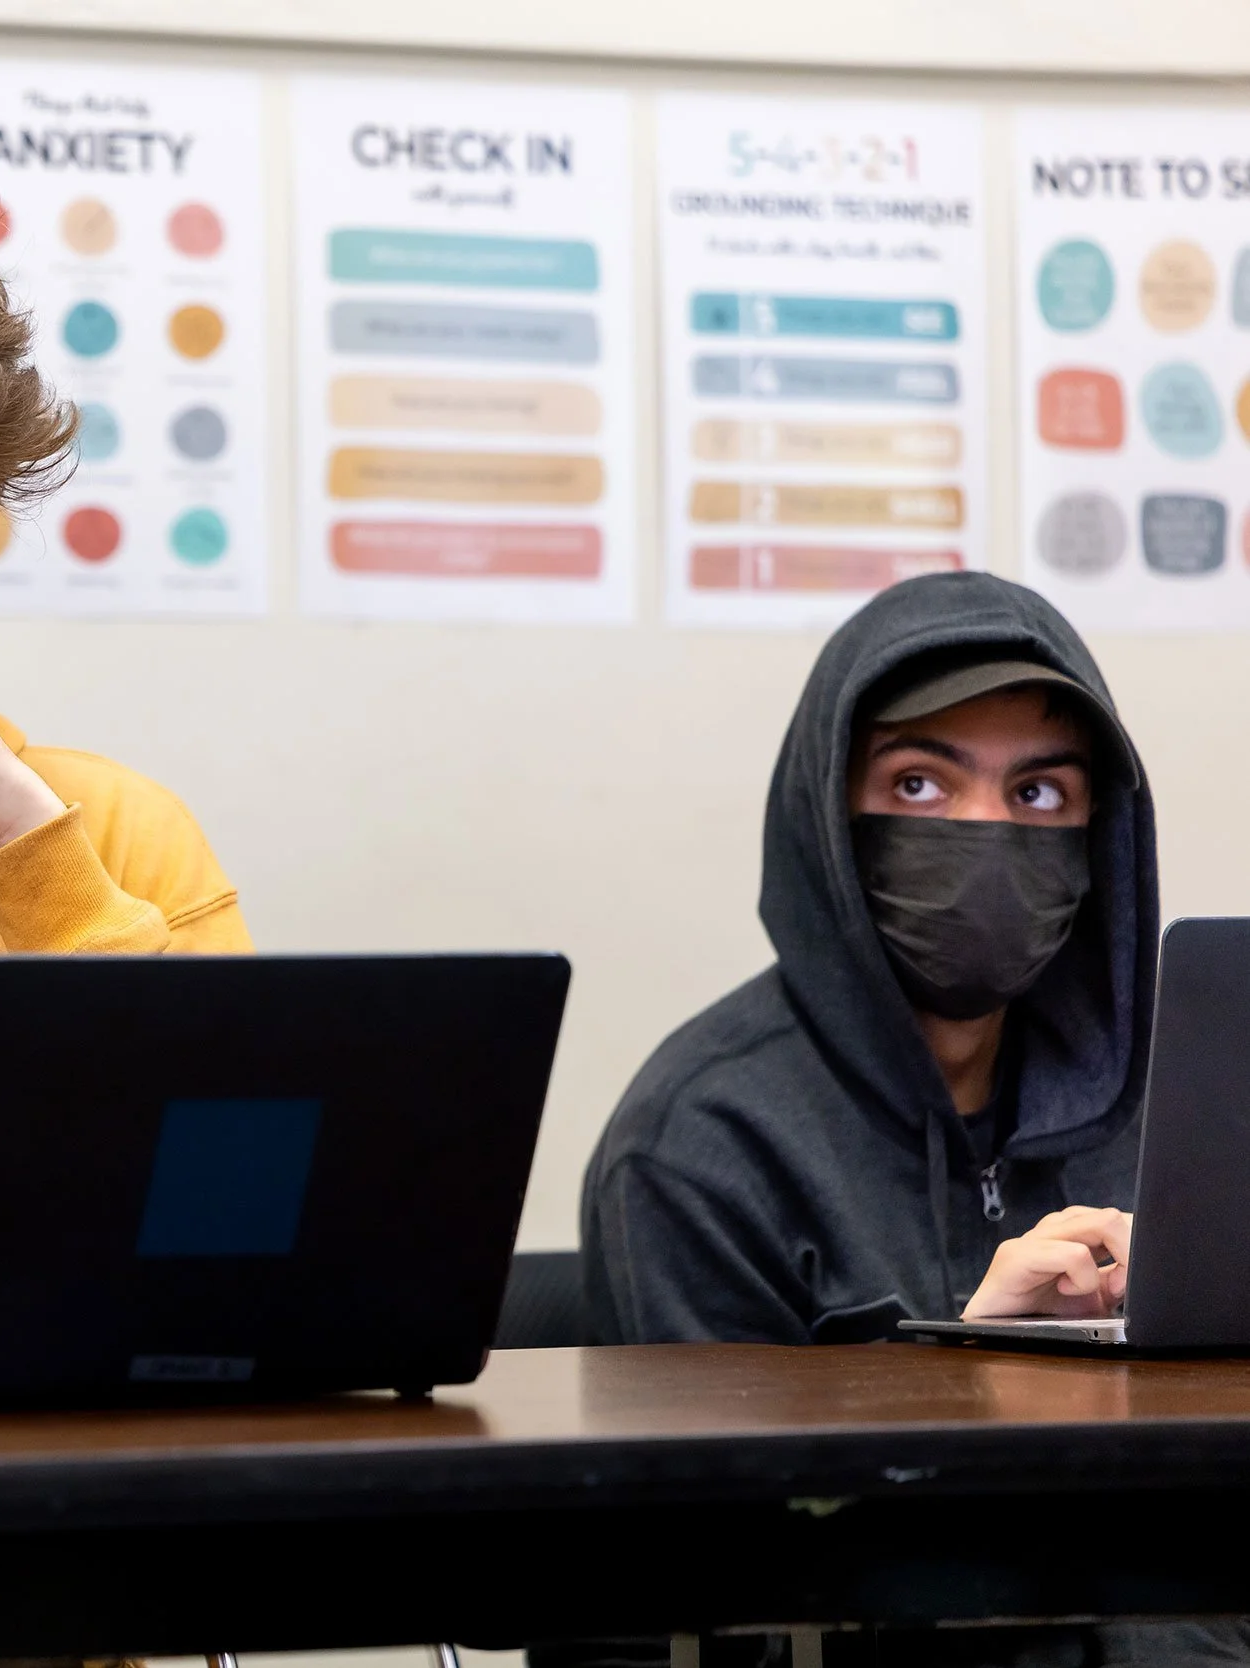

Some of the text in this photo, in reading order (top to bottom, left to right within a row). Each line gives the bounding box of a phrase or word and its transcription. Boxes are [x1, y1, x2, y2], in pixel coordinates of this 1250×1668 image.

[350, 124, 574, 175] CHECK IN
[1031, 156, 1144, 200] NOTE
[1153, 157, 1211, 199] TO
